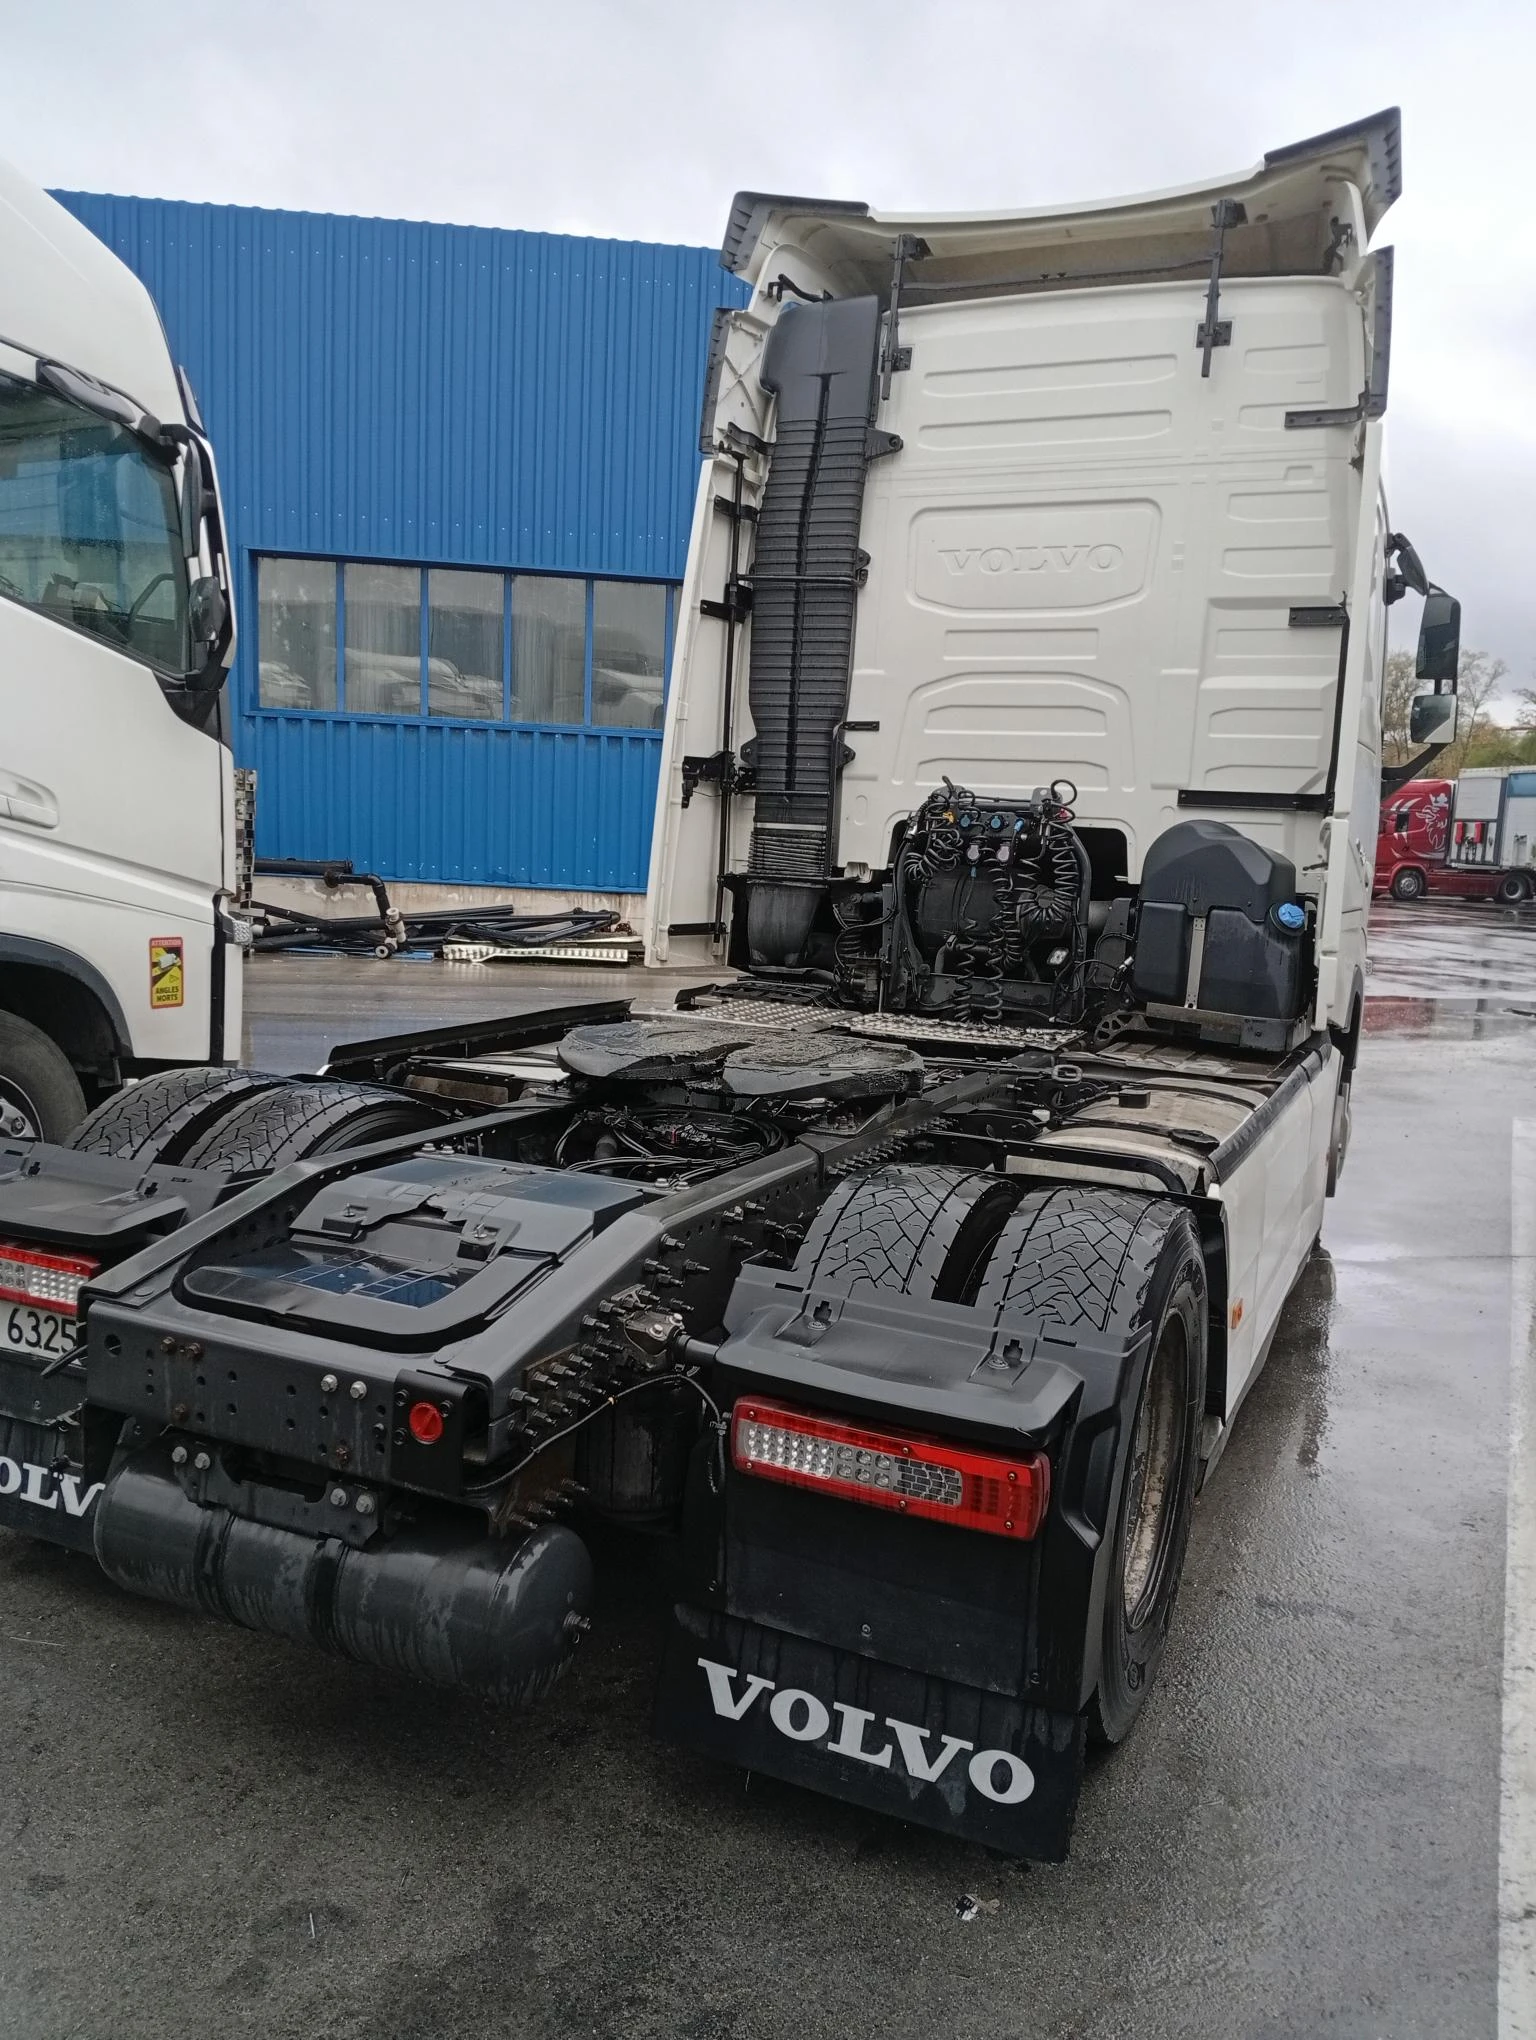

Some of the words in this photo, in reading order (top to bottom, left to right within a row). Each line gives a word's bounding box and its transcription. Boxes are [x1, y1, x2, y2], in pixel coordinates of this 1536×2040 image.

[937, 543, 1124, 576] VOLVO
[156, 994, 178, 1002] MORTS
[7, 1307, 78, 1354] 6325
[697, 1657, 1036, 1804] VOLVO
